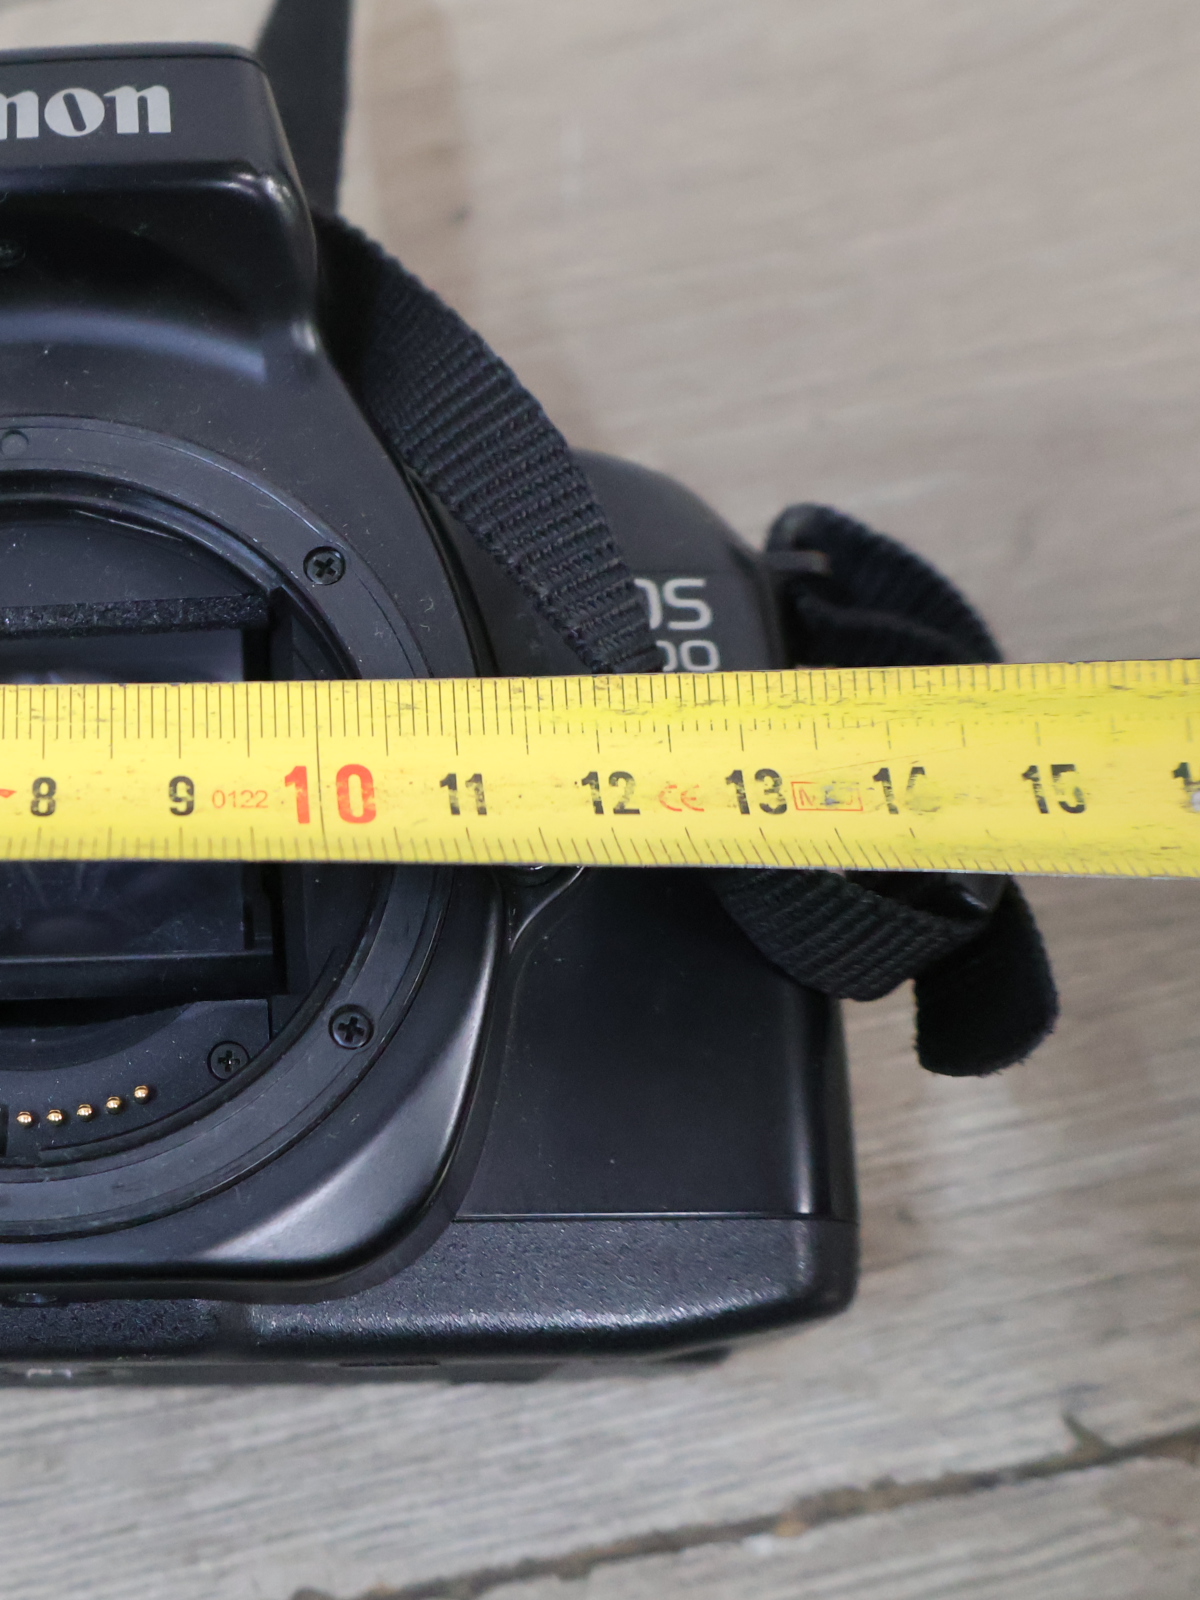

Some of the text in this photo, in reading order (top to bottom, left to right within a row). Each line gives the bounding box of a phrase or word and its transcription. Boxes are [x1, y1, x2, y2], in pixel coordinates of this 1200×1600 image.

[30, 776, 57, 817] 8
[168, 775, 195, 816] 9
[211, 790, 269, 809] 0122
[284, 764, 377, 825] 10
[439, 773, 488, 815] 11
[581, 771, 641, 815] 12
[726, 768, 788, 815] 13
[1021, 763, 1086, 814] 15
